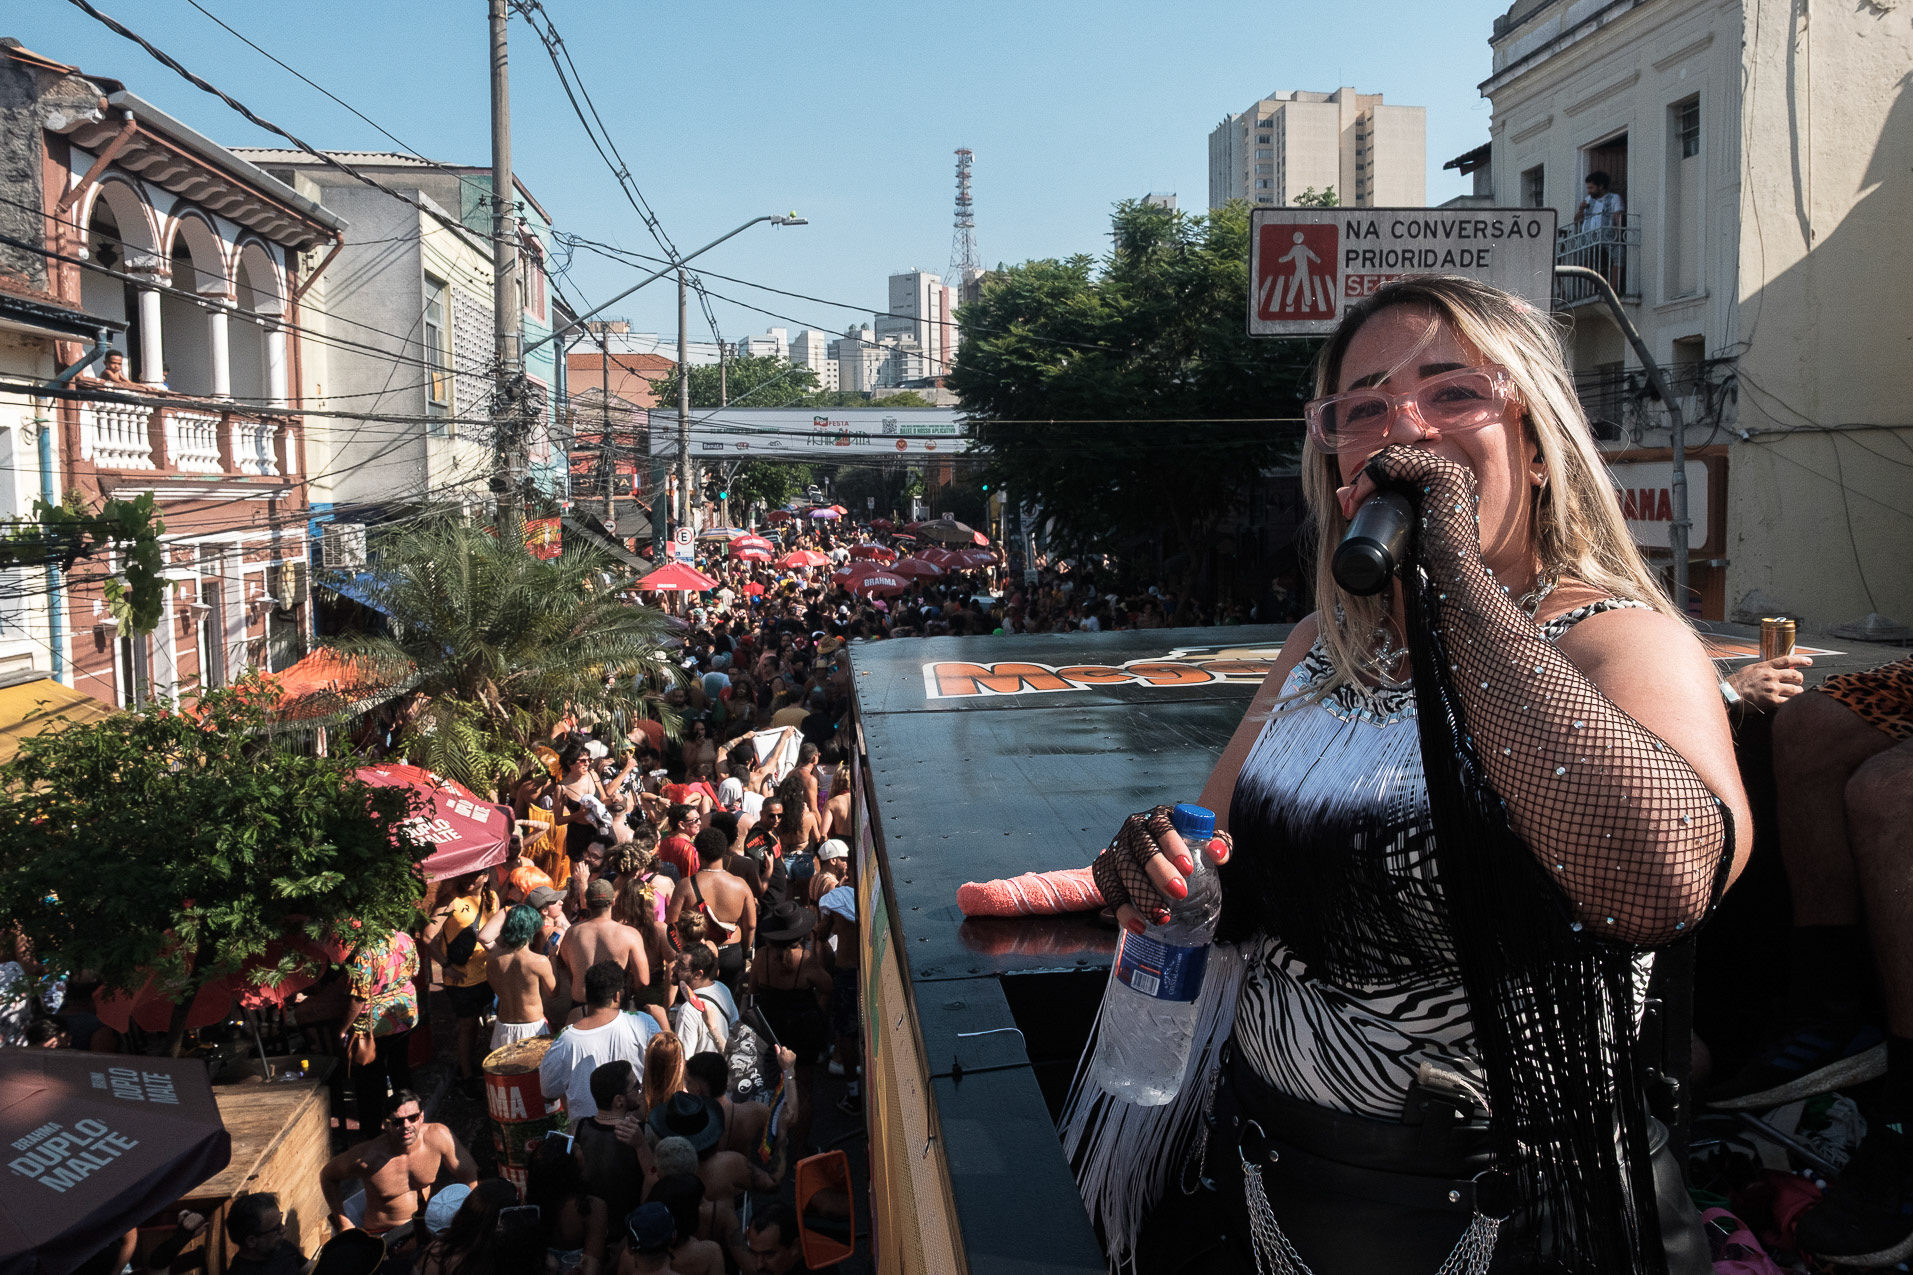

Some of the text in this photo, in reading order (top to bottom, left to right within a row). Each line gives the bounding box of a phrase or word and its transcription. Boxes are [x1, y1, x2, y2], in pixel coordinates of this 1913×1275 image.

[1346, 215, 1542, 240] NA CONVERSÃO
[1345, 249, 1490, 269] PRIORIDADE
[1615, 487, 1673, 521] ANA
[681, 532, 688, 542] E
[864, 577, 897, 587] BRAHMA
[108, 1067, 145, 1101] DUPLO
[7, 1118, 110, 1179] DUPLO
[10, 1121, 63, 1151] BRAHMA
[37, 1131, 140, 1193] MALTE
